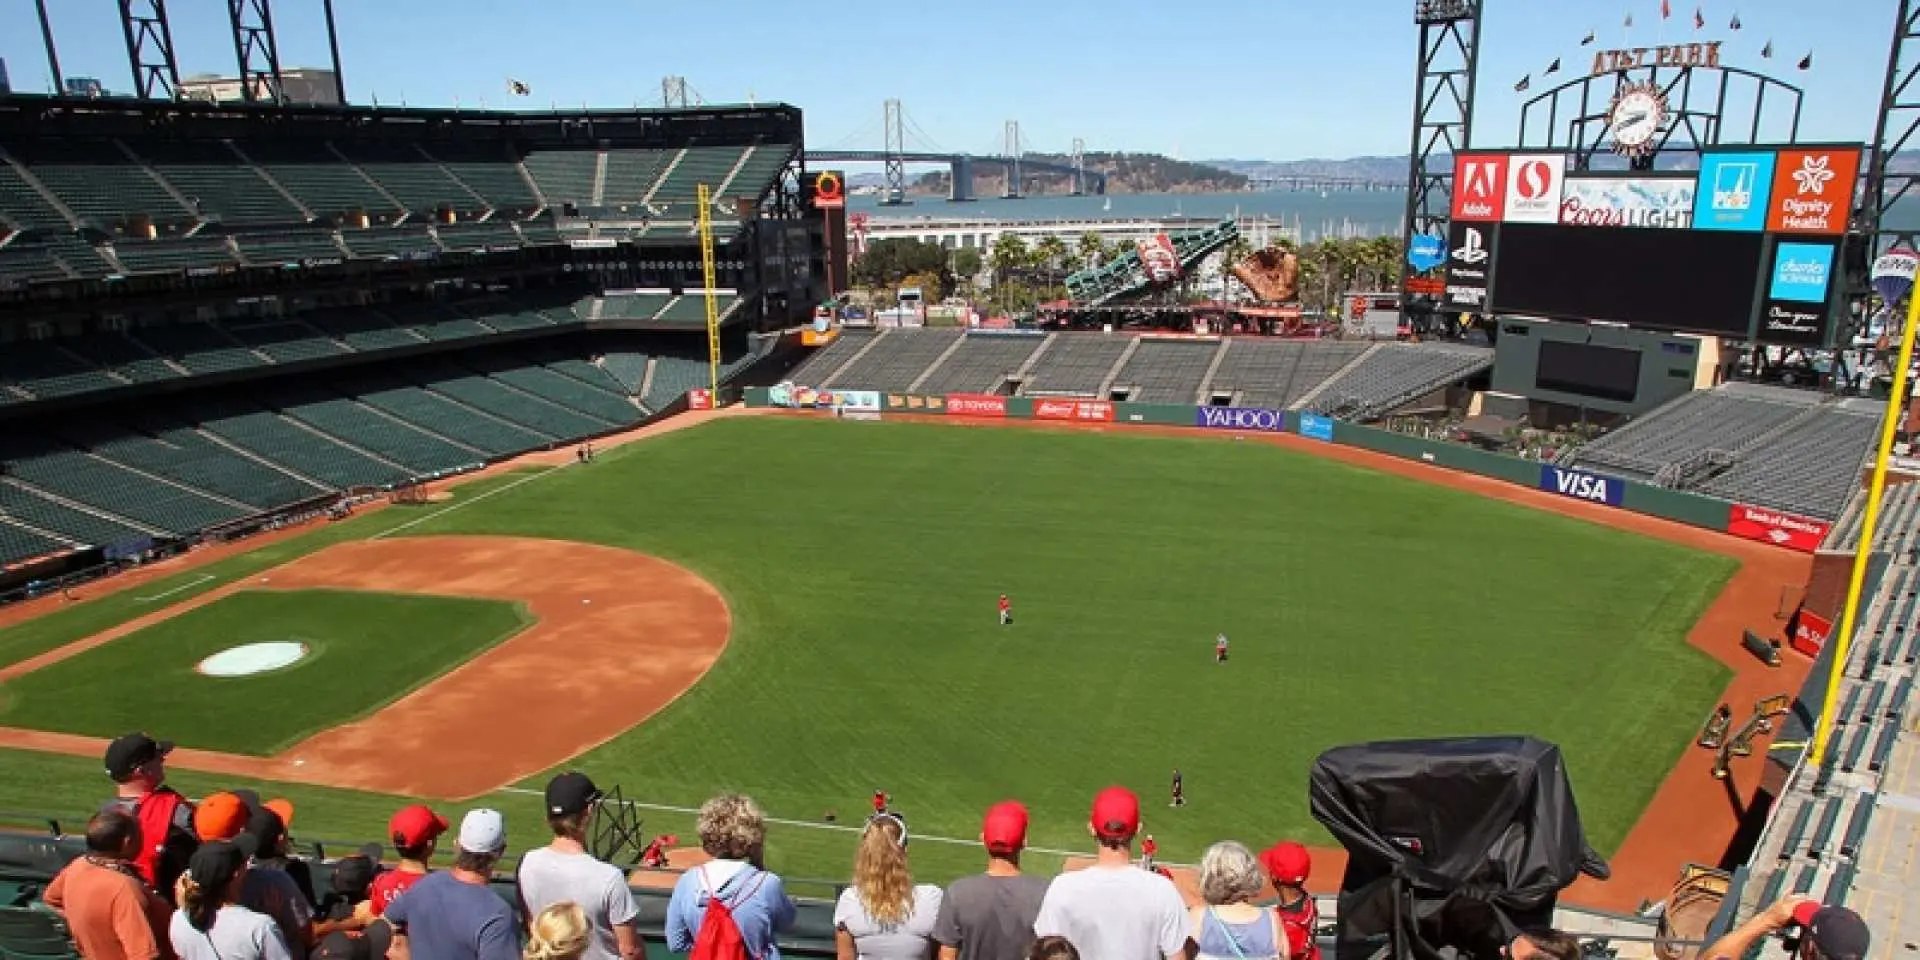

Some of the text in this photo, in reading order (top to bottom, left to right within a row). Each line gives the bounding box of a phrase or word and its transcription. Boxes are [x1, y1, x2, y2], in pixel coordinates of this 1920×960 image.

[1656, 42, 1720, 68] PARK
[1462, 201, 1493, 216] Adobe
[1558, 196, 1692, 228] Coors LIGHT
[1782, 199, 1832, 217] Dignity
[1782, 215, 1828, 229] Health
[963, 399, 1004, 411] TOYOTA
[1202, 407, 1280, 429] YAHOO!
[1554, 469, 1607, 502] VISA
